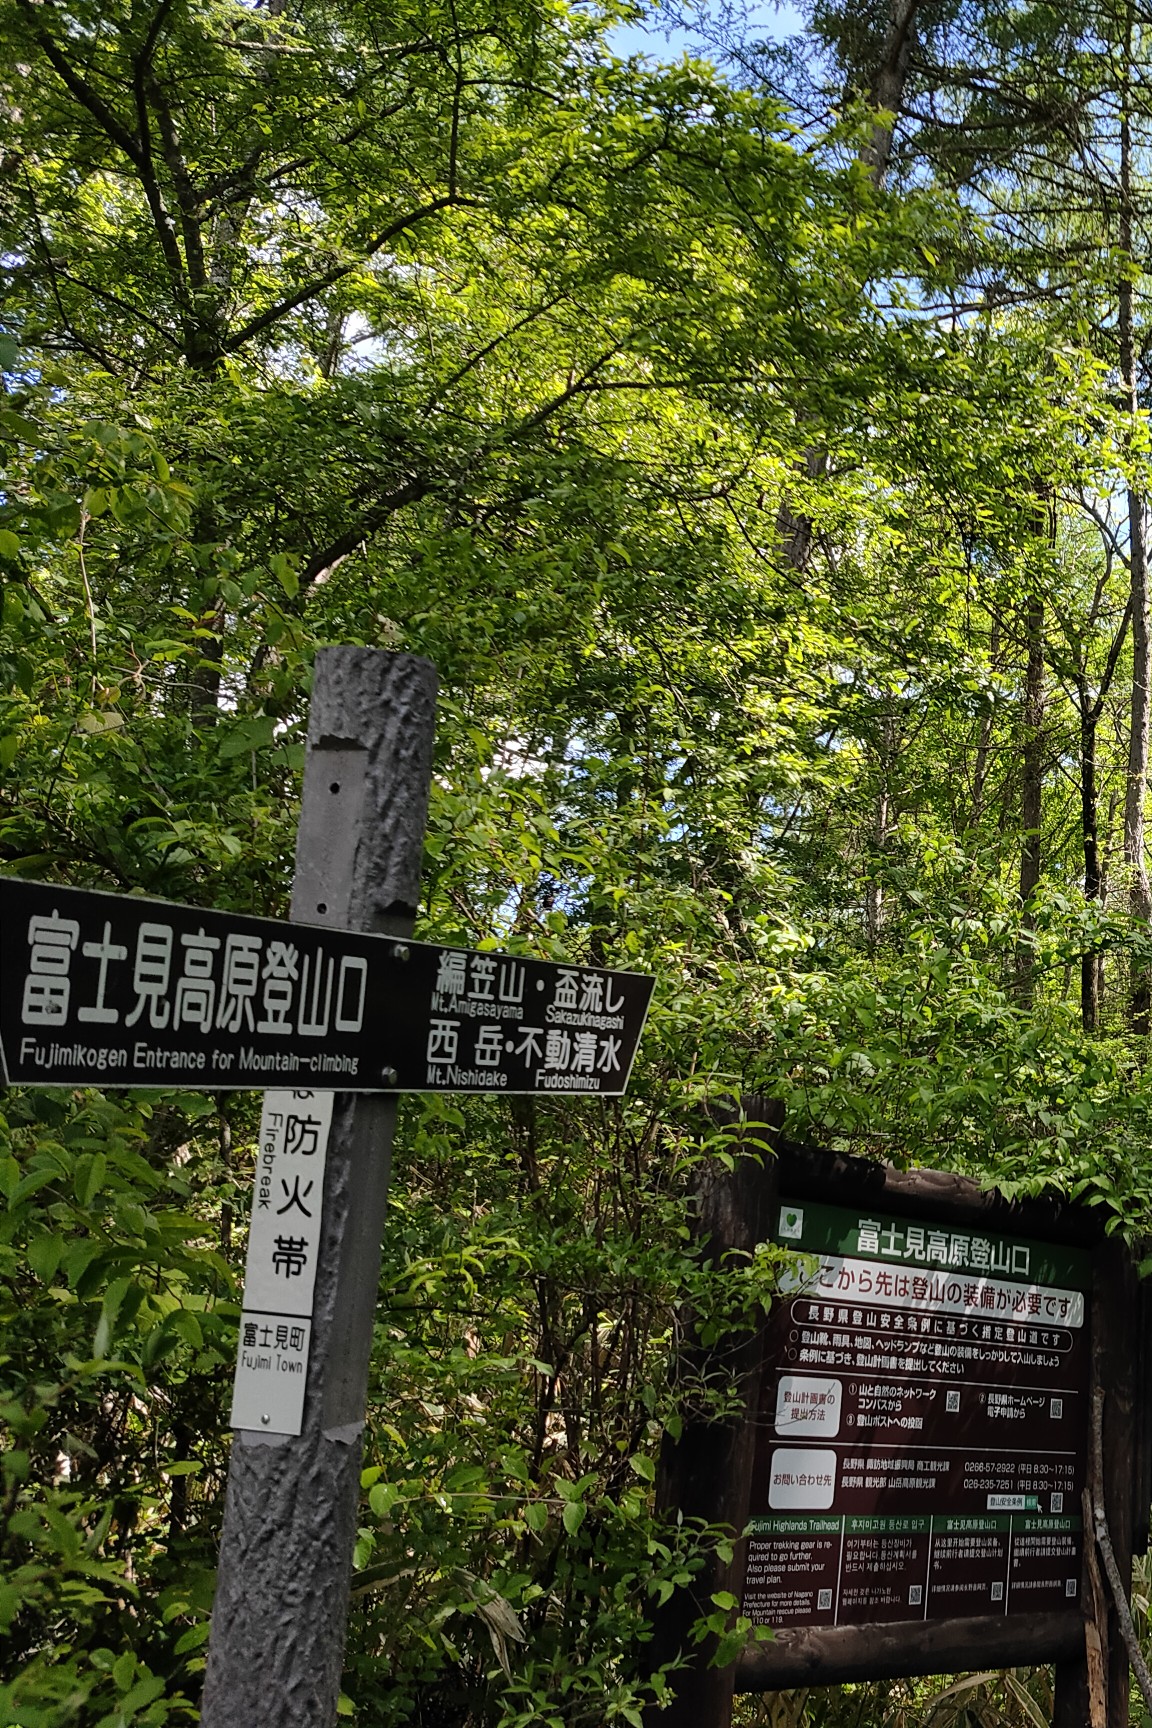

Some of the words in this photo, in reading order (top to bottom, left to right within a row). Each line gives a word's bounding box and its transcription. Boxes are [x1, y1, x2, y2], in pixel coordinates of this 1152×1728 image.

[21, 909, 367, 1036] 富士見高原登山口
[19, 1037, 127, 1070] Fujimikogen
[133, 1041, 205, 1069] Entrance
[212, 1049, 234, 1069] for
[239, 1046, 359, 1075] Mountain-climbing
[426, 1064, 507, 1088] Mt.Nishidake
[535, 1068, 600, 1091] Fudoshimizu
[258, 1112, 284, 1209] Firebreak
[272, 1090, 322, 1278] 防火帯
[857, 1218, 1031, 1276] 富士見高原登山口
[808, 1304, 1061, 1348] 長野県登山安全条例に基づく指定登山道です
[243, 1322, 307, 1351] 富士見町
[242, 1351, 272, 1371] Fujimi
[277, 1353, 303, 1374] Town
[784, 1391, 836, 1405] 登山計画書の
[858, 1384, 937, 1403] 山と自然のネットワーク
[791, 1408, 826, 1422] 提出方法
[773, 1473, 833, 1487] お問い合わせ先
[772, 1519, 807, 1533] Highlands
[809, 1519, 840, 1531] Trailhead
[911, 1519, 925, 1530] 입구
[749, 1540, 772, 1552] Proper
[773, 1540, 800, 1551] trekking
[801, 1541, 815, 1551] gear
[816, 1540, 823, 1550] is
[748, 1552, 770, 1563] quired
[770, 1552, 778, 1561] to
[778, 1553, 789, 1562] go
[789, 1551, 813, 1561] further.
[747, 1564, 763, 1573] Also
[763, 1564, 786, 1574] please
[787, 1563, 810, 1573] submit
[811, 1563, 825, 1574] your
[746, 1575, 765, 1585] travel
[766, 1575, 782, 1585] plan.
[757, 1592, 766, 1600] the
[766, 1591, 787, 1600] website
[794, 1590, 814, 1600] Nagano
[743, 1600, 771, 1609] Prefecture
[779, 1600, 792, 1608] more
[752, 1608, 776, 1617] Mountain
[776, 1608, 794, 1616] rescue
[794, 1607, 812, 1616] please
